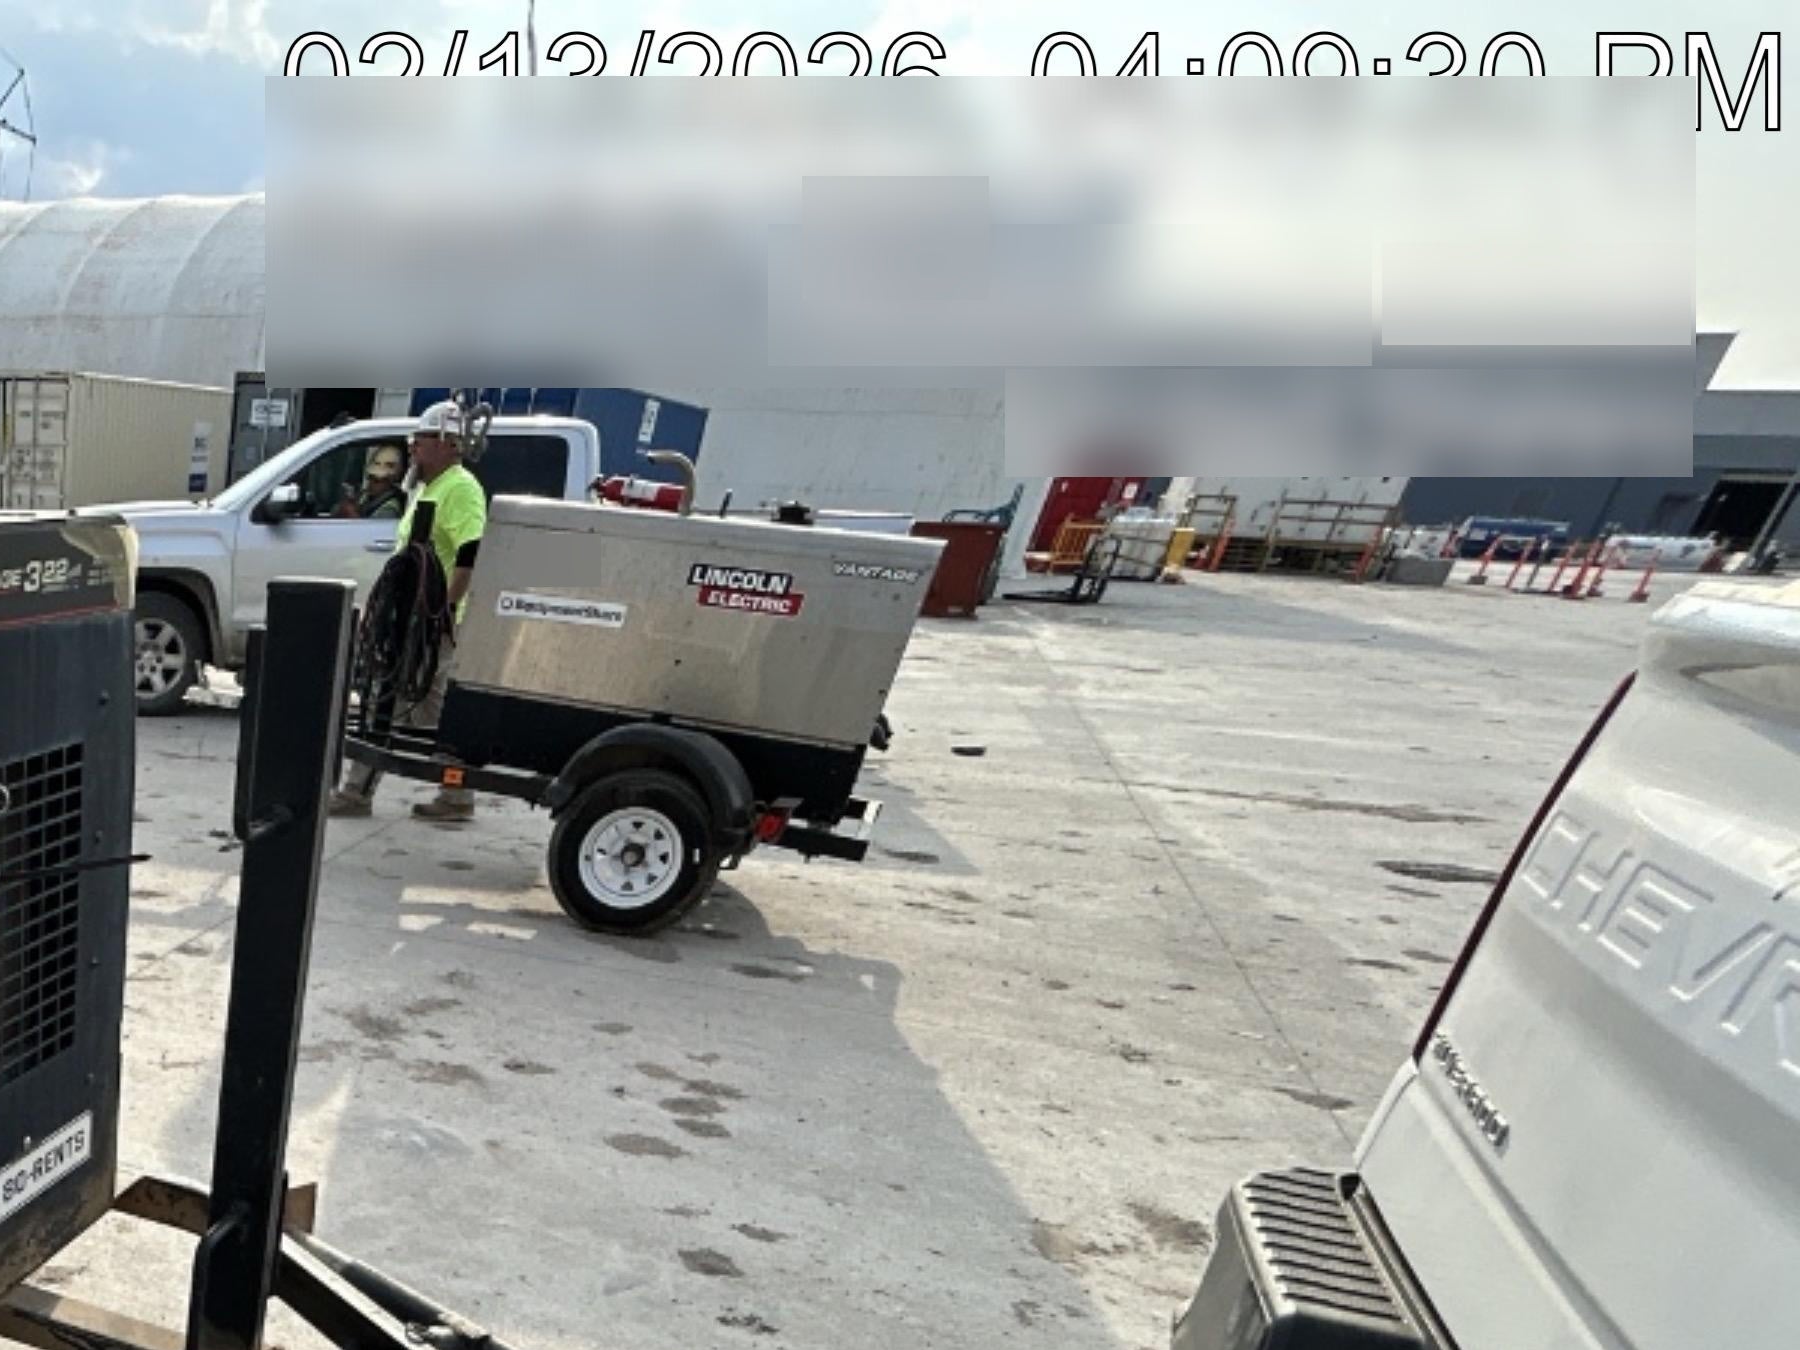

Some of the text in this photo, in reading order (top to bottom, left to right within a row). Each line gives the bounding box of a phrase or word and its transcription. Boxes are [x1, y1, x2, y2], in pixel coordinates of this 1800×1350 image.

[692, 566, 788, 593] LINCOLN
[832, 563, 919, 583] VANTAGE
[706, 590, 792, 613] ELECTRIC
